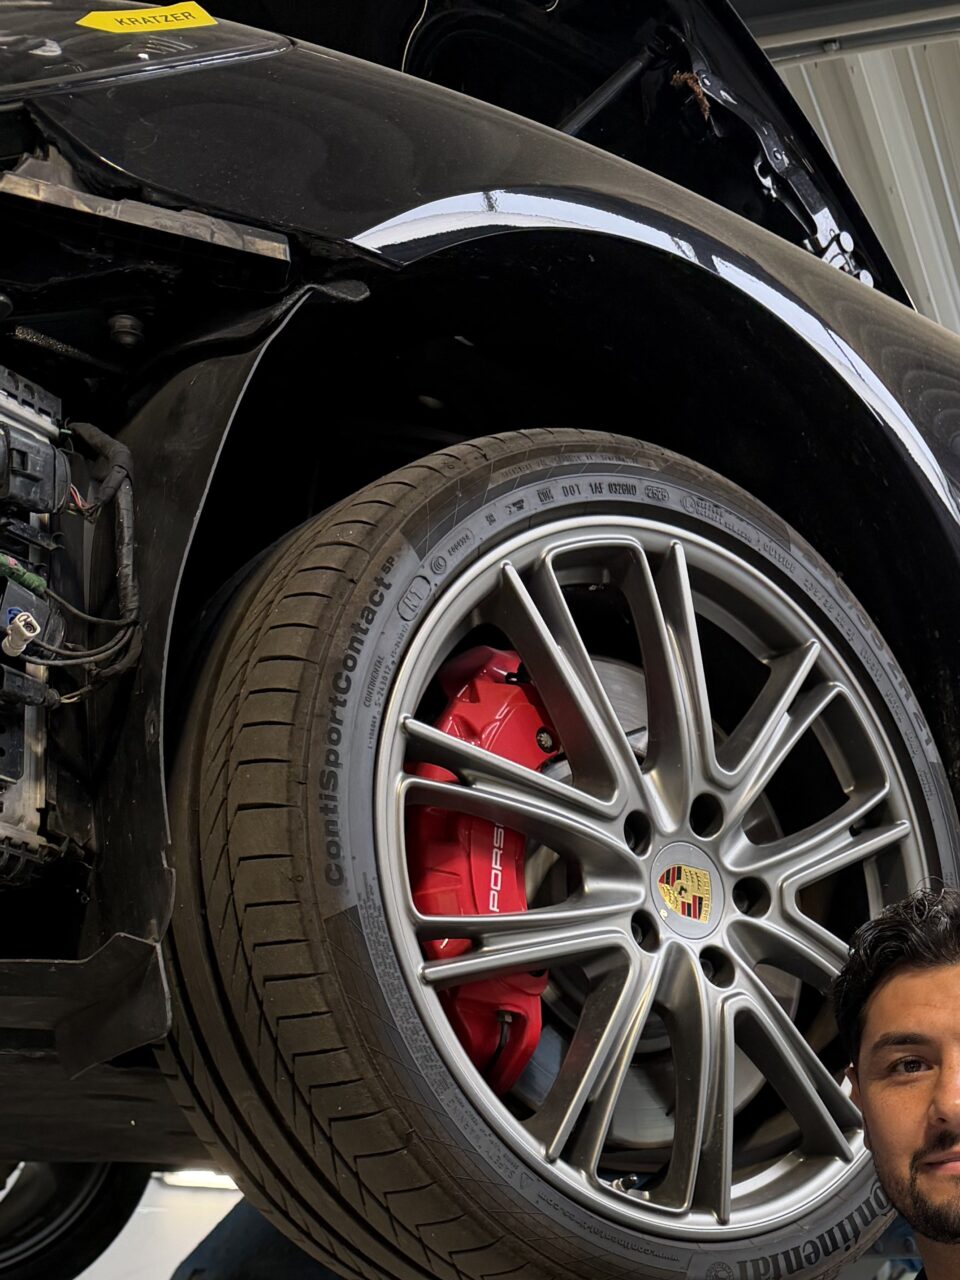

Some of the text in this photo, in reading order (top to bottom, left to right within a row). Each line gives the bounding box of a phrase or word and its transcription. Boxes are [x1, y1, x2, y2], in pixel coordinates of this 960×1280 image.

[114, 11, 197, 26] KRATZER
[363, 655, 385, 708] CONTINENTAL
[489, 822, 505, 912] PORS
